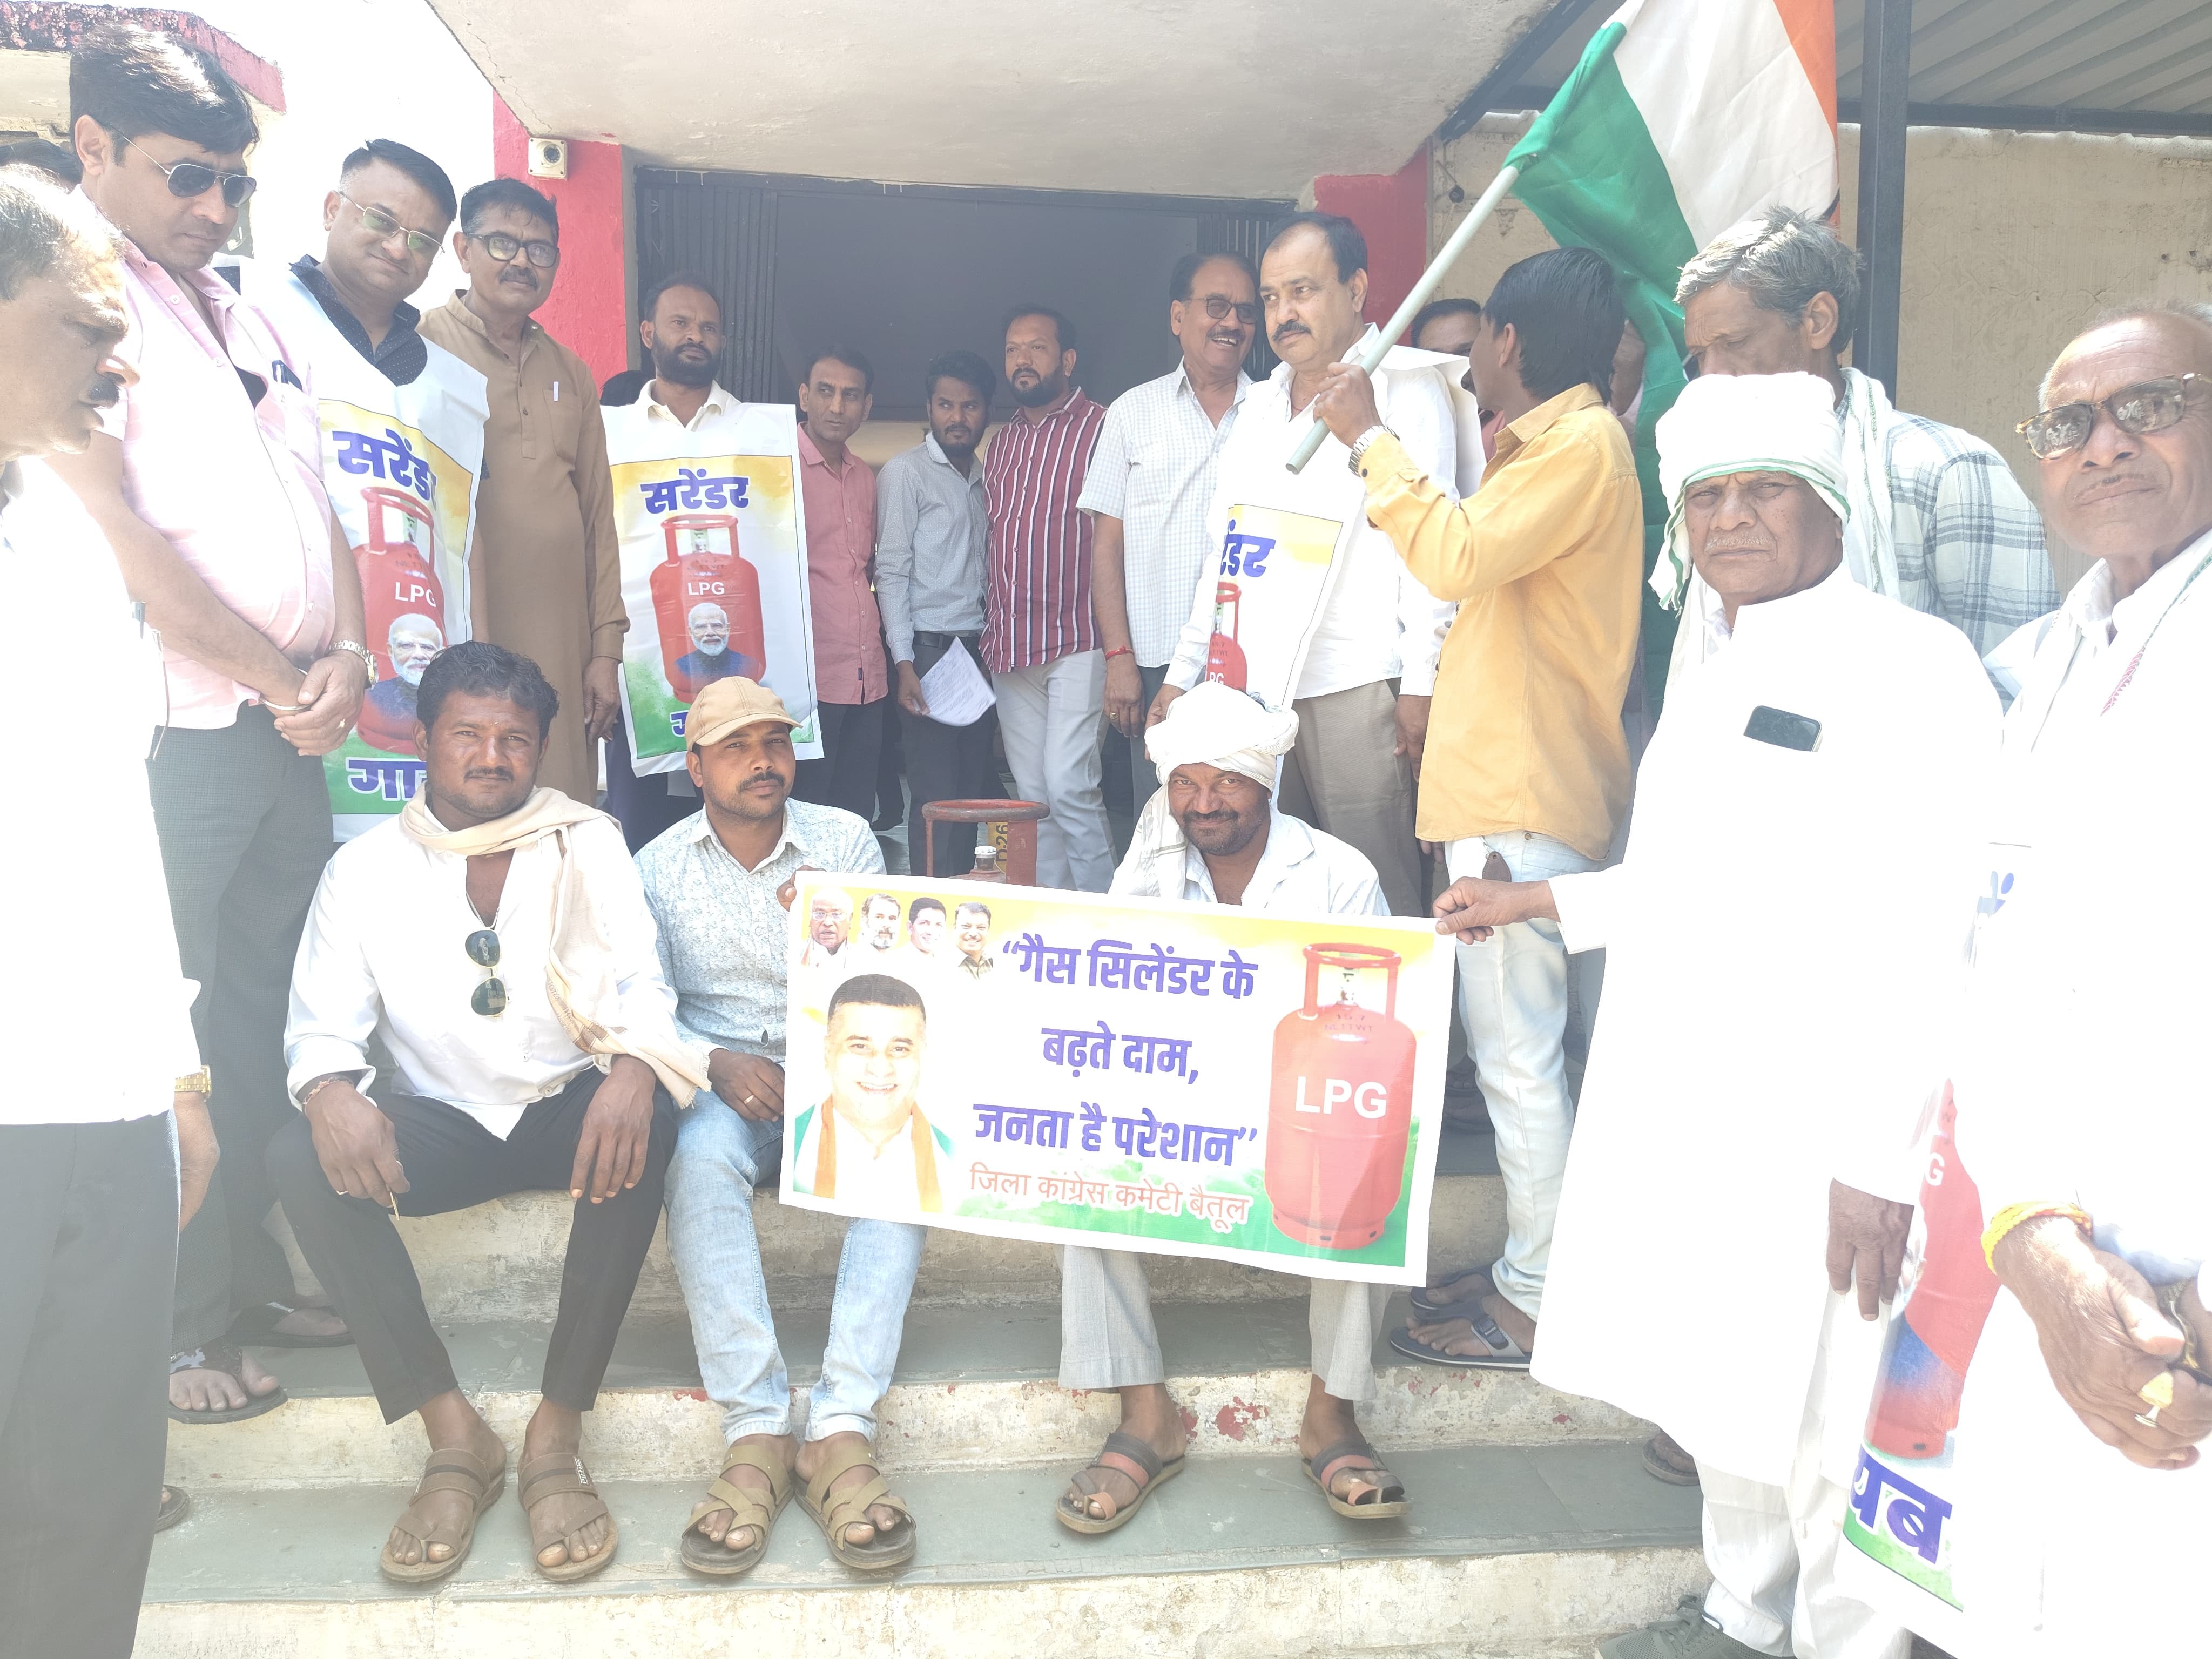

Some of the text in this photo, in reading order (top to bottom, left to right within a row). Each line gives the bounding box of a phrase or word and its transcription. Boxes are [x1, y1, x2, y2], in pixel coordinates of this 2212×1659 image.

[640, 468, 750, 514] सरेंडर
[395, 582, 436, 608] LPG
[687, 582, 725, 596] LPG
[1003, 933, 1258, 999] “गैस सिलेंडर के
[1041, 1020, 1198, 1084] बढ़ते दाम,
[1296, 1076, 1387, 1119] LPG
[973, 1101, 1258, 1166] जनता है परेशान”
[970, 1162, 1250, 1230] जिला कांग्रेस कमेटी बैतूल
[1850, 1444, 1952, 1564] यब
